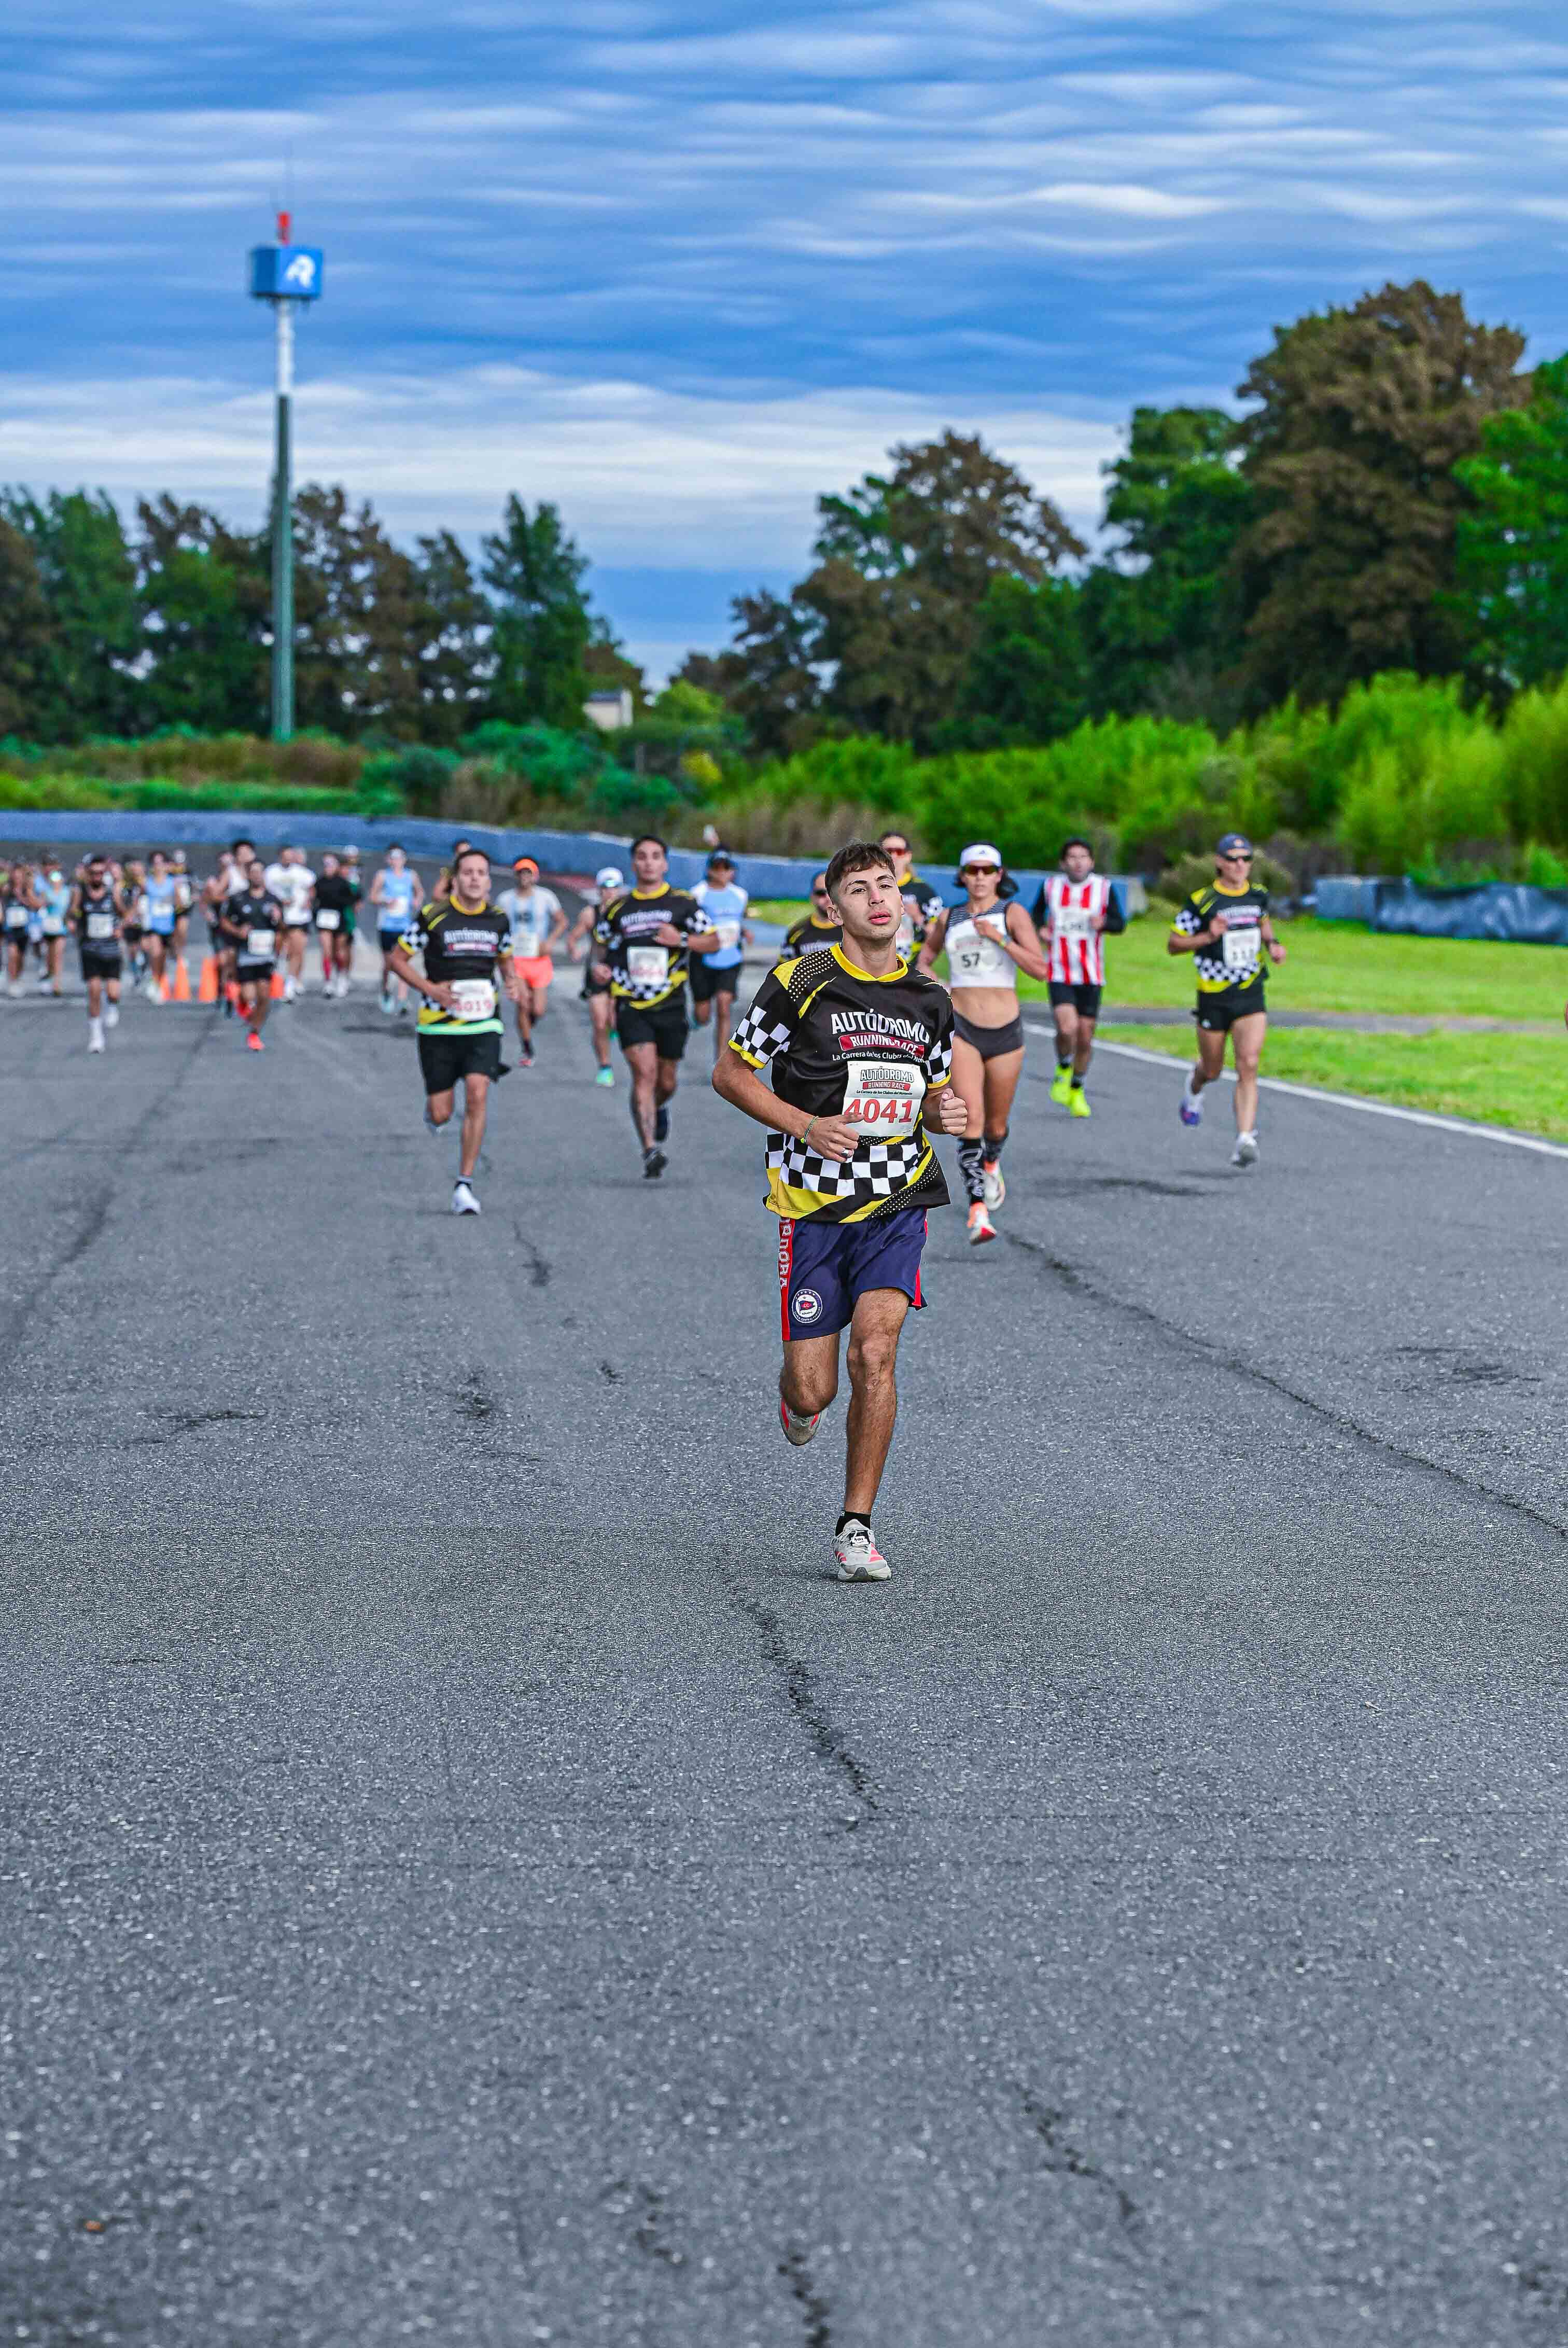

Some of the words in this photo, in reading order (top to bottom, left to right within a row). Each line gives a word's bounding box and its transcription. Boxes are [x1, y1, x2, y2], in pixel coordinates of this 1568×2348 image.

[831, 1008, 930, 1044] AUTÓDROMO
[860, 1066, 914, 1083] AUTÓDROMO
[844, 1099, 913, 1123] 4041
